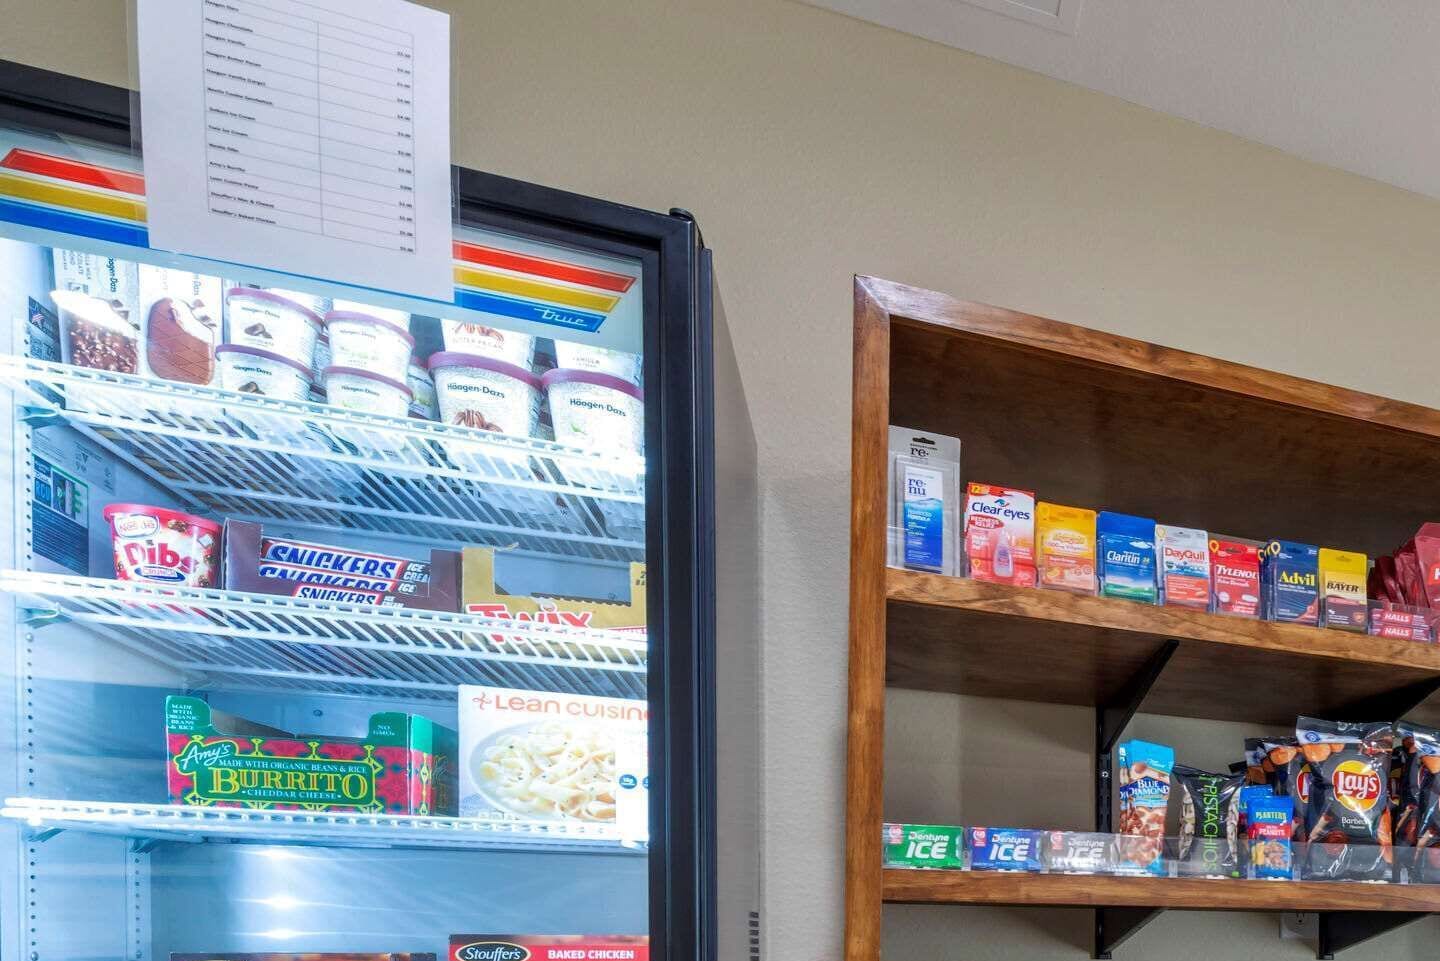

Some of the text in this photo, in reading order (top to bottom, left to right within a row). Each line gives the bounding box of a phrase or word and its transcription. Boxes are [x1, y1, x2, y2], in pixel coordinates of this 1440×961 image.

[534, 305, 588, 327] true
[972, 502, 1030, 521] Clear eyes
[1106, 550, 1140, 564] Claritin
[1165, 547, 1205, 561] DayQuil
[266, 544, 400, 580] SNICKERS
[407, 562, 425, 573] ICE
[403, 571, 429, 582] CREA
[1215, 564, 1258, 579] TYLENOL
[1279, 571, 1315, 586] Advil
[1327, 582, 1359, 592] BAYER
[298, 587, 376, 605] SNICKERS
[1385, 613, 1409, 622] HALLS
[1385, 628, 1409, 636] HALLS
[495, 695, 560, 714] Lean
[181, 743, 233, 770] Amy's
[218, 759, 239, 767] MADE
[243, 760, 269, 769] WITH
[270, 762, 310, 771] ORGANIC
[311, 763, 338, 772] BEANS
[348, 766, 366, 774] RICE
[208, 767, 368, 800] BURRITO
[1127, 785, 1169, 796] DIAMOND
[1137, 779, 1159, 789] BLUE
[1337, 771, 1378, 800] Lay's
[247, 789, 338, 799] CHEDDAR CHEESE
[1203, 785, 1219, 870] PISTACHIOS
[909, 831, 950, 843] Dentyne
[991, 833, 1031, 844] Dentyne
[1068, 838, 1105, 849] Dentyne
[906, 841, 949, 859] ICE
[988, 843, 1028, 861] ICE
[465, 947, 521, 961] Stouffer's
[548, 950, 635, 959] BAKED CHICKEN
